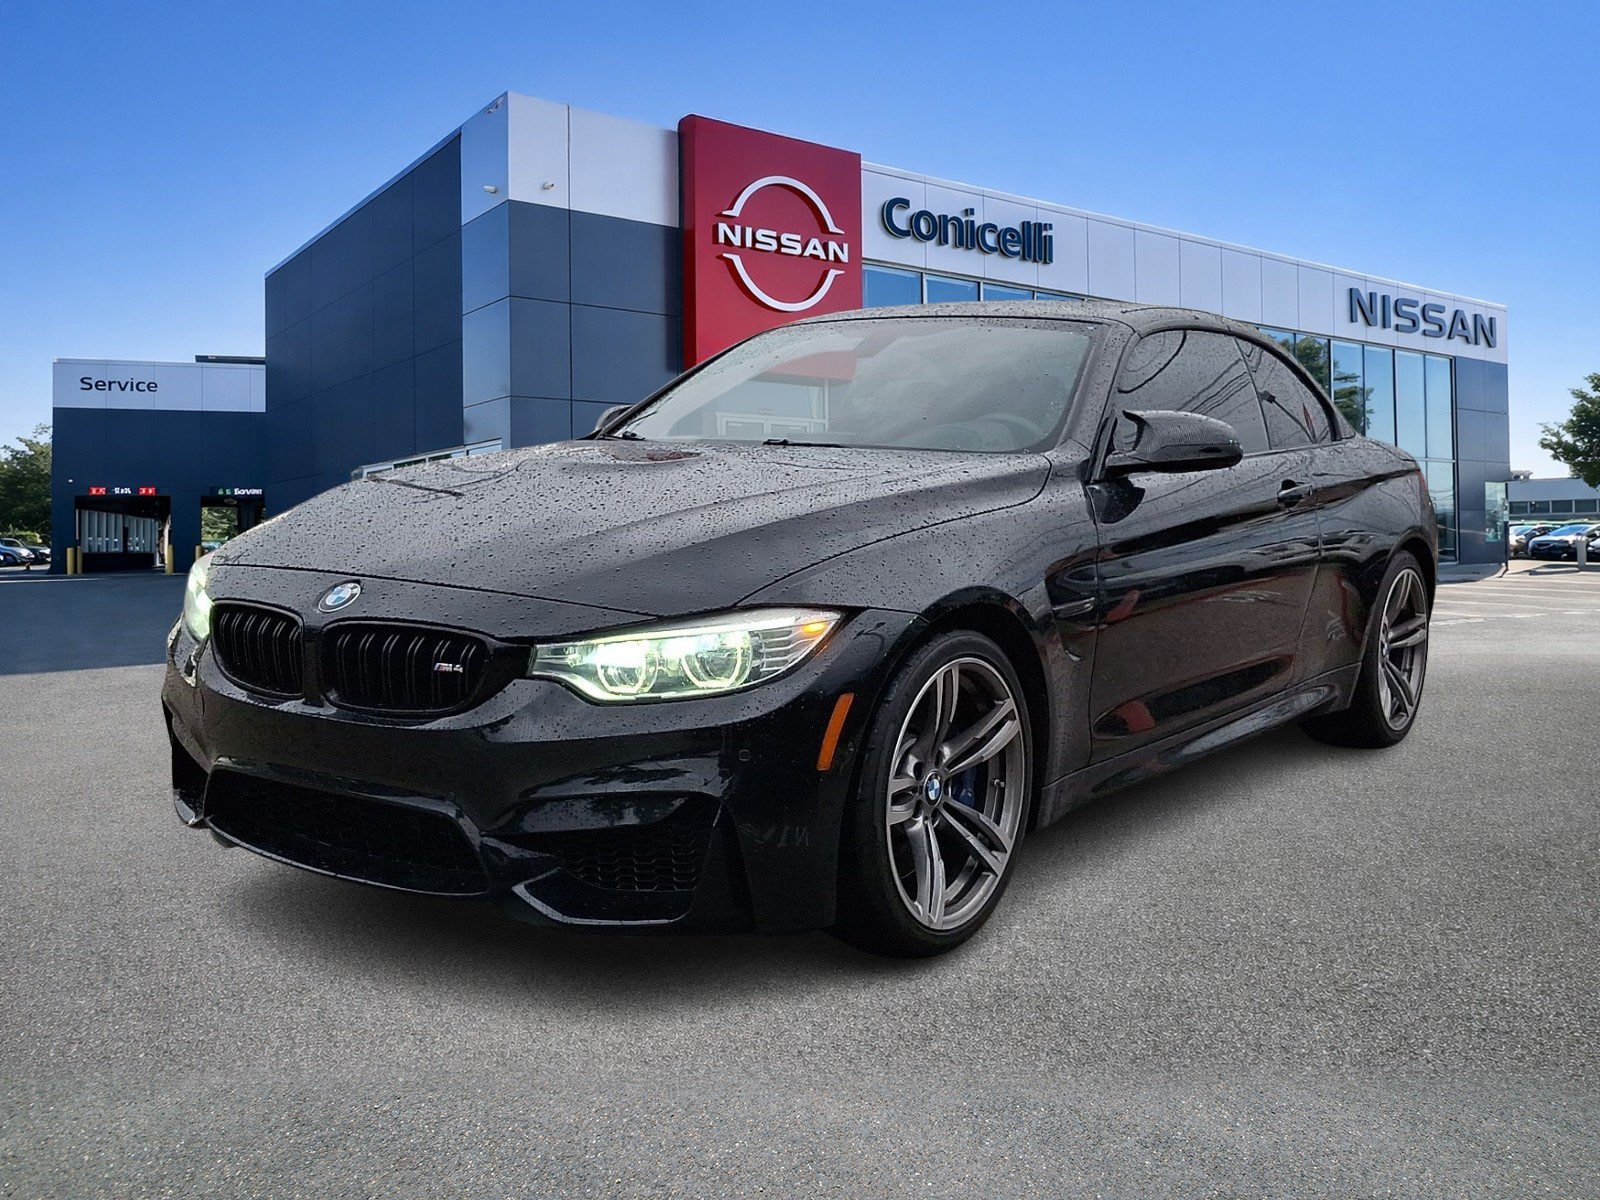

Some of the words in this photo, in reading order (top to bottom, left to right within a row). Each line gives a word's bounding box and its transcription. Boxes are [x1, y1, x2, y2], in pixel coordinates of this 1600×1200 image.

[717, 222, 849, 263] NISSAN
[881, 197, 1053, 264] Conicelli
[1349, 287, 1497, 348] NISSAN
[80, 376, 158, 393] Service
